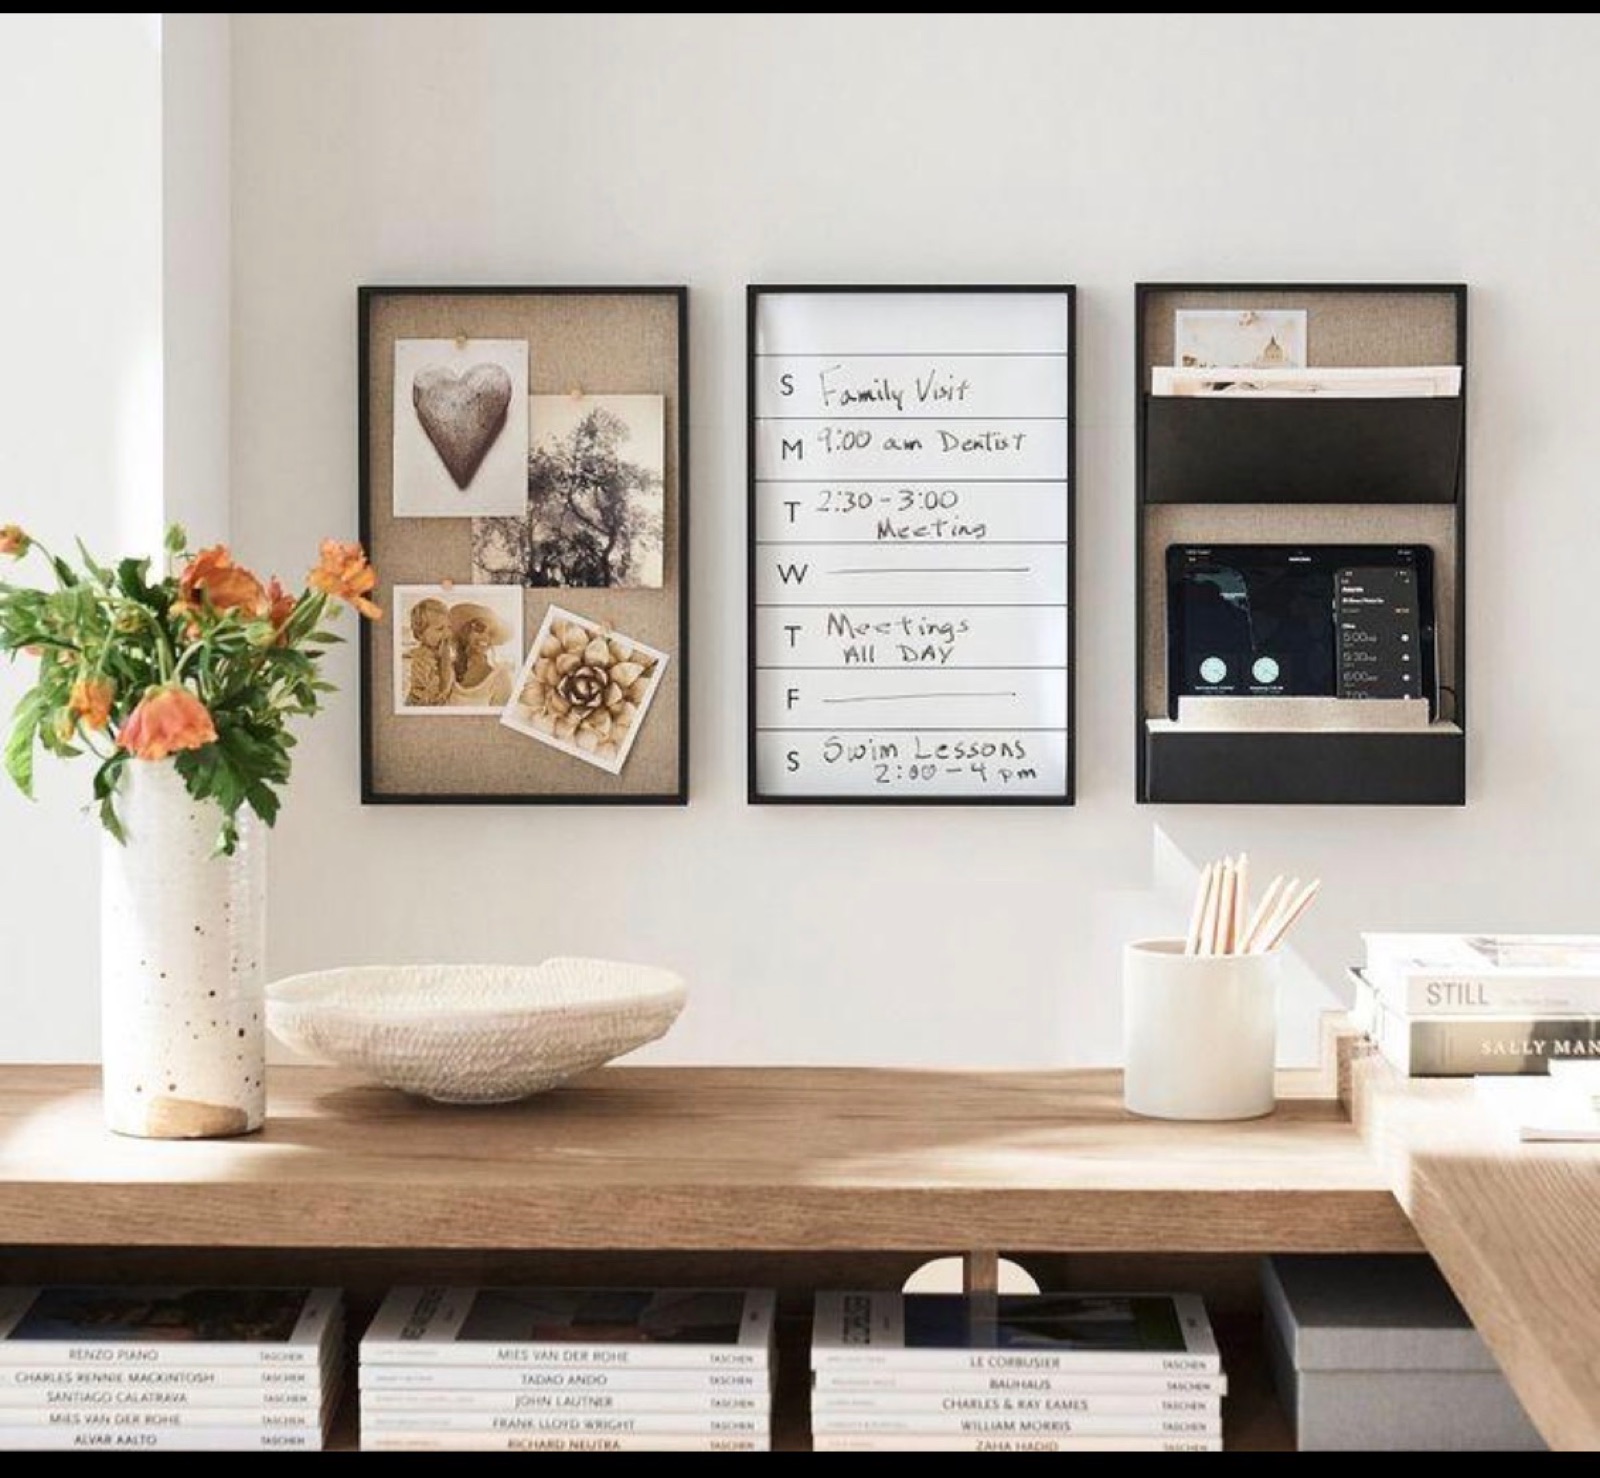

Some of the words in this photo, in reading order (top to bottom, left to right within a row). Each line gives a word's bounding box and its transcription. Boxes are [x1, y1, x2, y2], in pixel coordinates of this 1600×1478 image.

[780, 374, 794, 396] S
[820, 365, 903, 411] Family
[915, 369, 969, 402] Visit
[782, 439, 803, 460] M
[817, 427, 872, 453] 9:00
[883, 439, 922, 450] am
[937, 430, 1026, 452] Dentist
[784, 502, 801, 523] T
[877, 516, 986, 540] Meeting
[776, 564, 808, 584] W
[784, 626, 801, 648] T
[828, 613, 969, 644] Meetings
[898, 645, 953, 664] DAY
[787, 689, 799, 709] F
[824, 736, 899, 763] Swim
[915, 737, 1026, 760] Lessons
[787, 751, 800, 772] S
[998, 769, 1036, 783] pm
[1426, 982, 1489, 1006] STILL
[1481, 1040, 1546, 1055] SALLY
